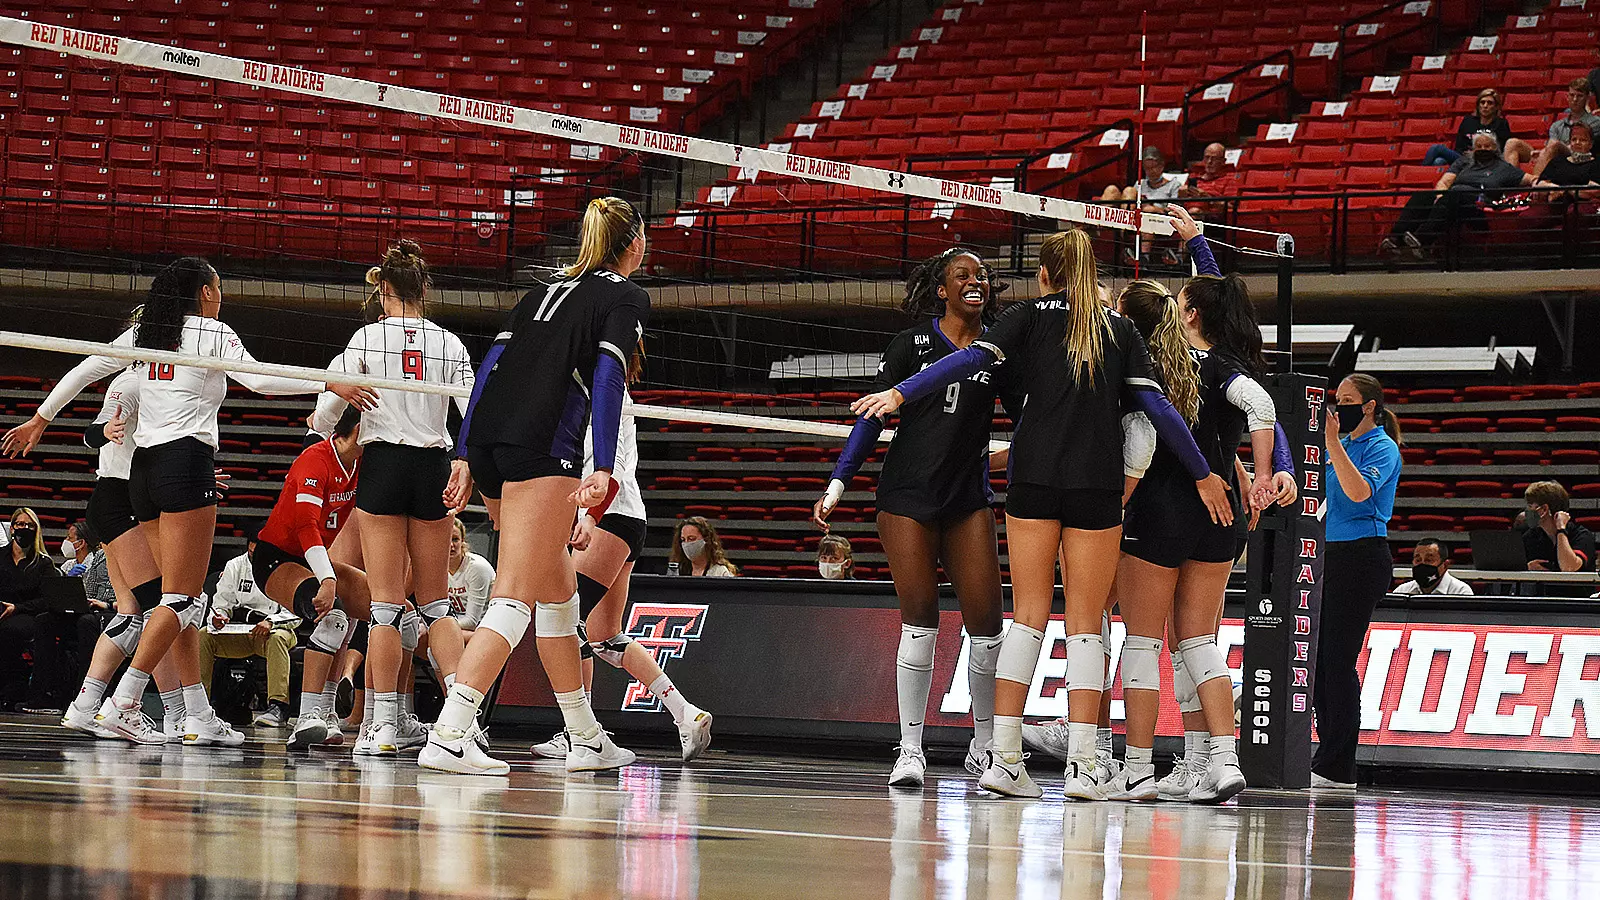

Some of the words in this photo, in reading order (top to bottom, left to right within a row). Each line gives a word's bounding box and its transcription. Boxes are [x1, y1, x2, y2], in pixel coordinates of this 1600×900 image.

[31, 23, 57, 44] RED
[62, 29, 120, 55] RAIDERS
[162, 50, 200, 67] molten
[242, 61, 268, 82] RED
[270, 66, 325, 91] RAIDERS
[438, 96, 461, 115] RED
[464, 100, 514, 123] RAIDERS
[551, 118, 582, 133] molten
[618, 127, 640, 145] RED
[643, 131, 689, 153] RAIDERS
[786, 155, 806, 172] RED
[808, 158, 850, 180] RAIDERS
[940, 181, 960, 198] RED
[961, 184, 1002, 204] RAIDERS
[1085, 205, 1101, 220] RED
[533, 280, 581, 322] 17
[914, 334, 930, 345] BLM
[402, 350, 424, 381] 9
[943, 381, 960, 414] 9
[1302, 444, 1321, 517] RED
[1293, 537, 1317, 712] RAIDERS
[1356, 628, 1600, 740] IDER
[1252, 669, 1272, 744] Senoh
